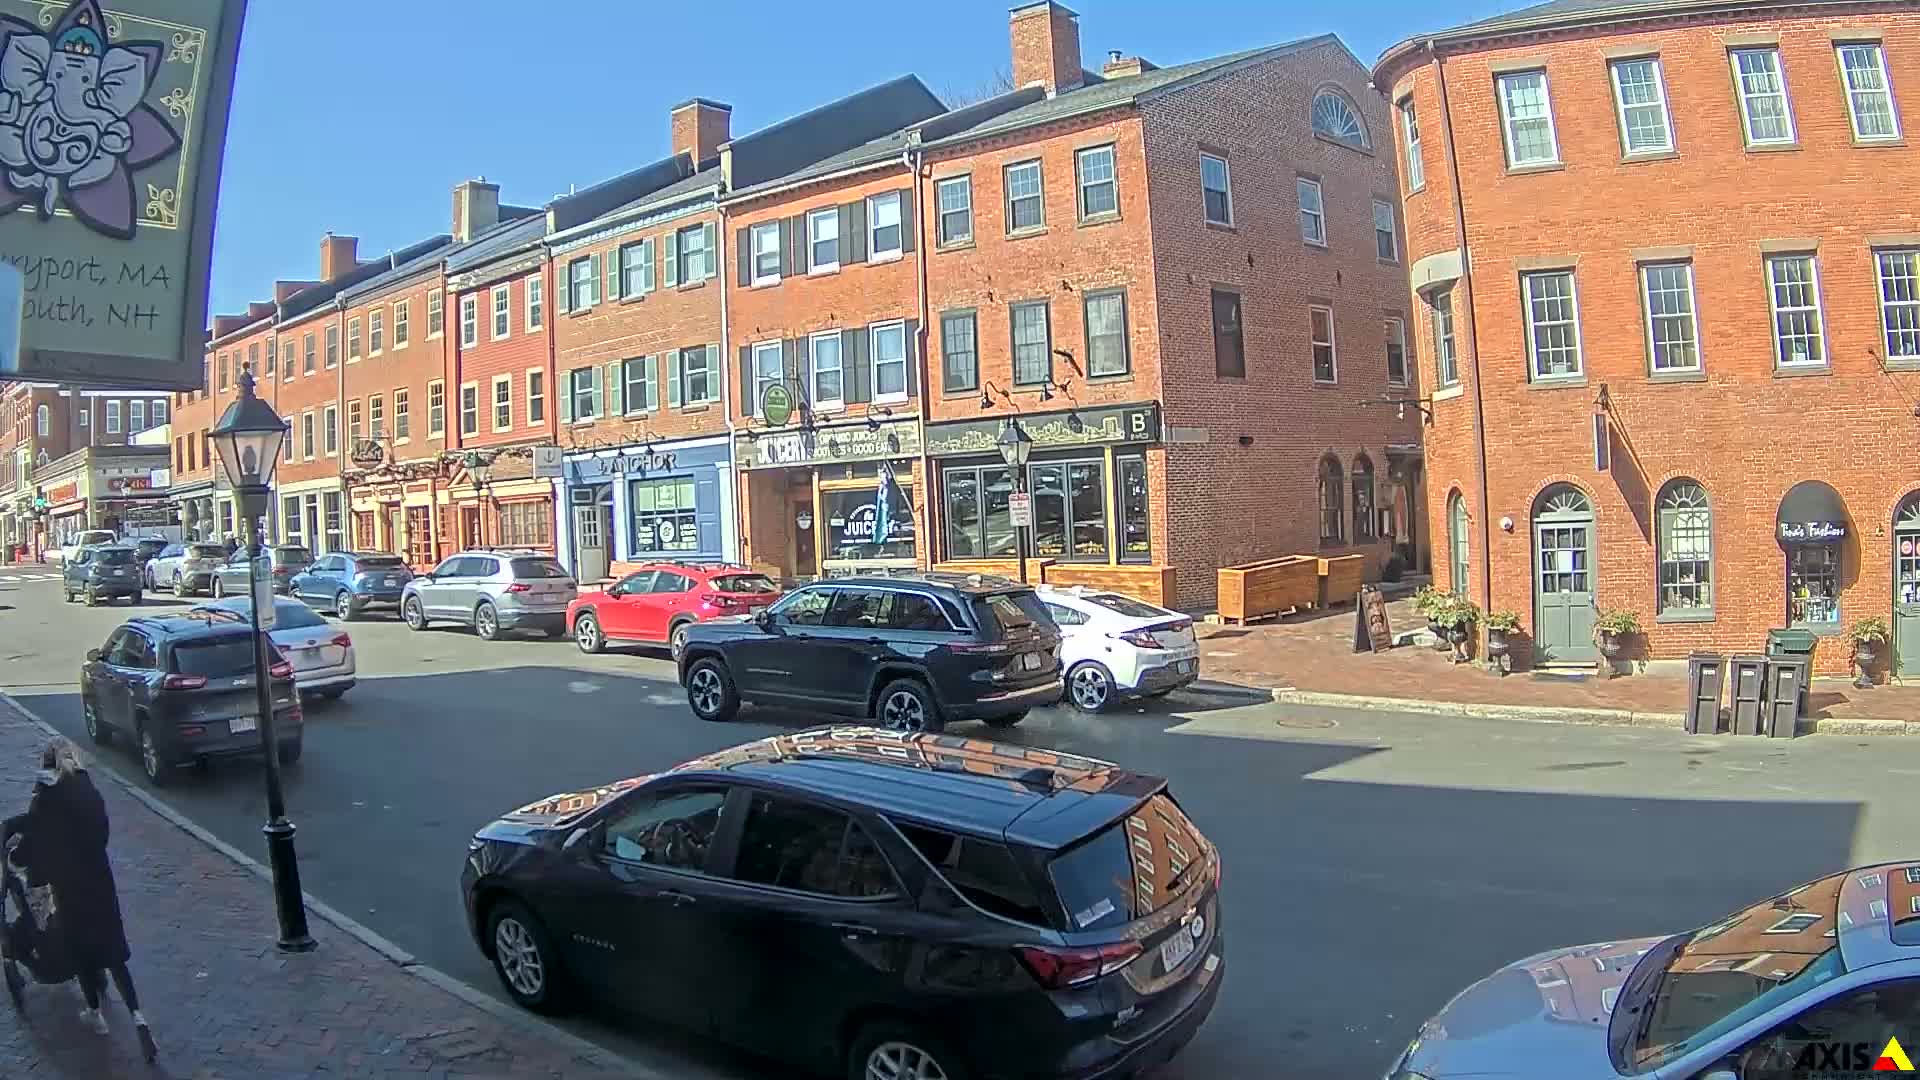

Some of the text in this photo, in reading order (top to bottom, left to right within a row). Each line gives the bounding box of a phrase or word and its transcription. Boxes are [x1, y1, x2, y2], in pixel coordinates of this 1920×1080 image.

[0, 254, 171, 292] ryport, MA
[107, 303, 160, 331] NH
[611, 453, 678, 474] ANCHOR
[843, 519, 895, 536] JUICEY
